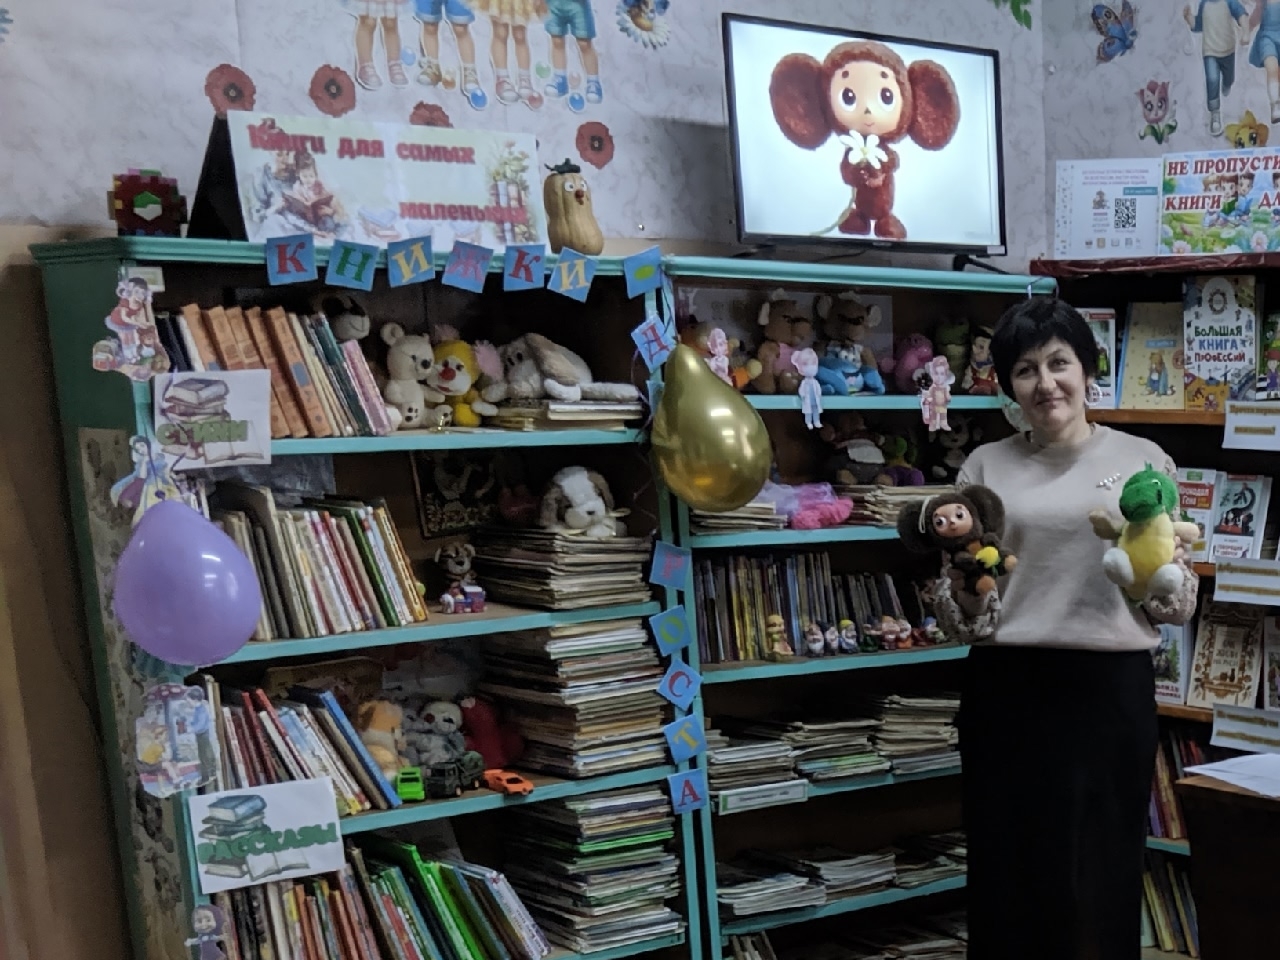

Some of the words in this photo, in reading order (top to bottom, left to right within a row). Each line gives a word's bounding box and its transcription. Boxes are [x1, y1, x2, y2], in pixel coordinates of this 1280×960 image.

[336, 135, 385, 160] для
[396, 142, 476, 165] самых
[1167, 161, 1189, 177] НЕ
[1164, 194, 1222, 212] КНИГИ
[1198, 338, 1239, 350] КНИГА
[196, 822, 339, 865] РАССКАЗЫ
